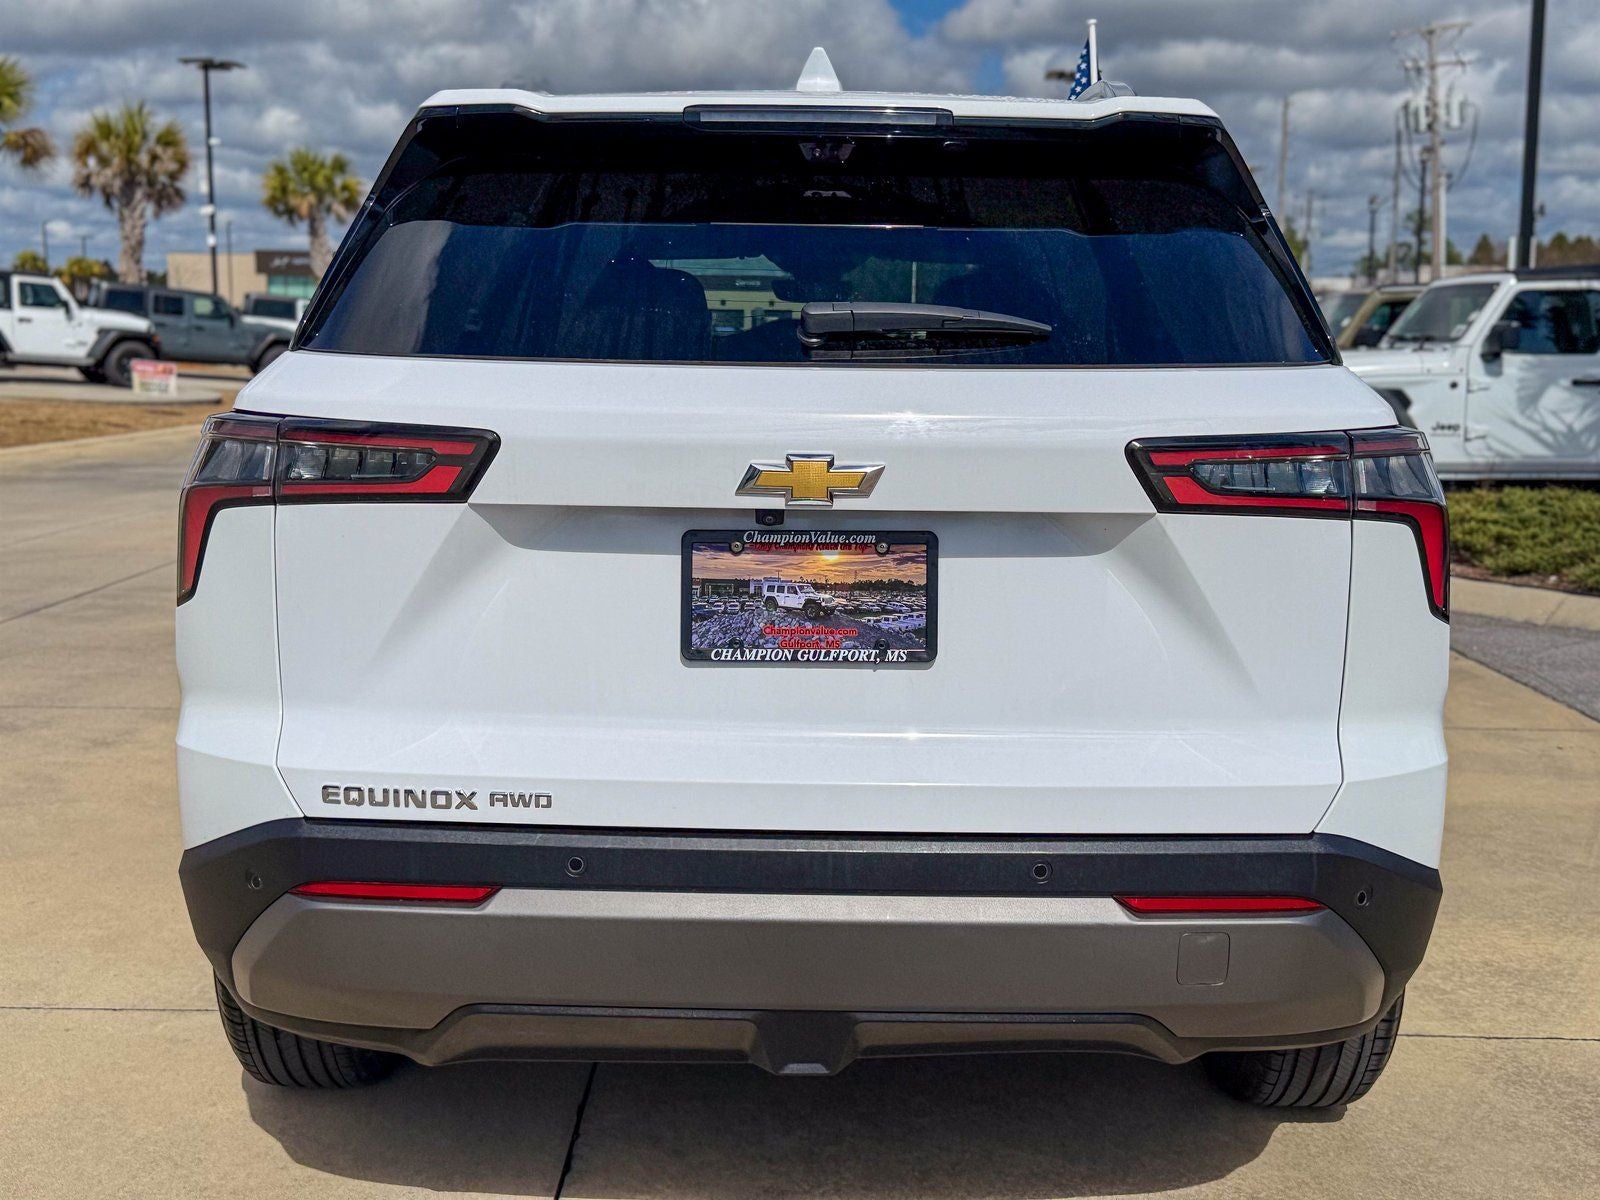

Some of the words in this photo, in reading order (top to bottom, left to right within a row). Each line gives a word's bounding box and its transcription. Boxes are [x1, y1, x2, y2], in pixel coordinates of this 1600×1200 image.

[1431, 421, 1461, 432] Jeep
[743, 531, 876, 546] ChampionValue.com
[763, 625, 858, 638] Championvalue.com
[826, 640, 841, 649] MS
[710, 648, 792, 662] CHAMPION
[797, 649, 881, 664] GULFPORT,
[885, 650, 908, 663] MS
[321, 784, 478, 810] EQUINOX
[489, 791, 553, 808] AWD
